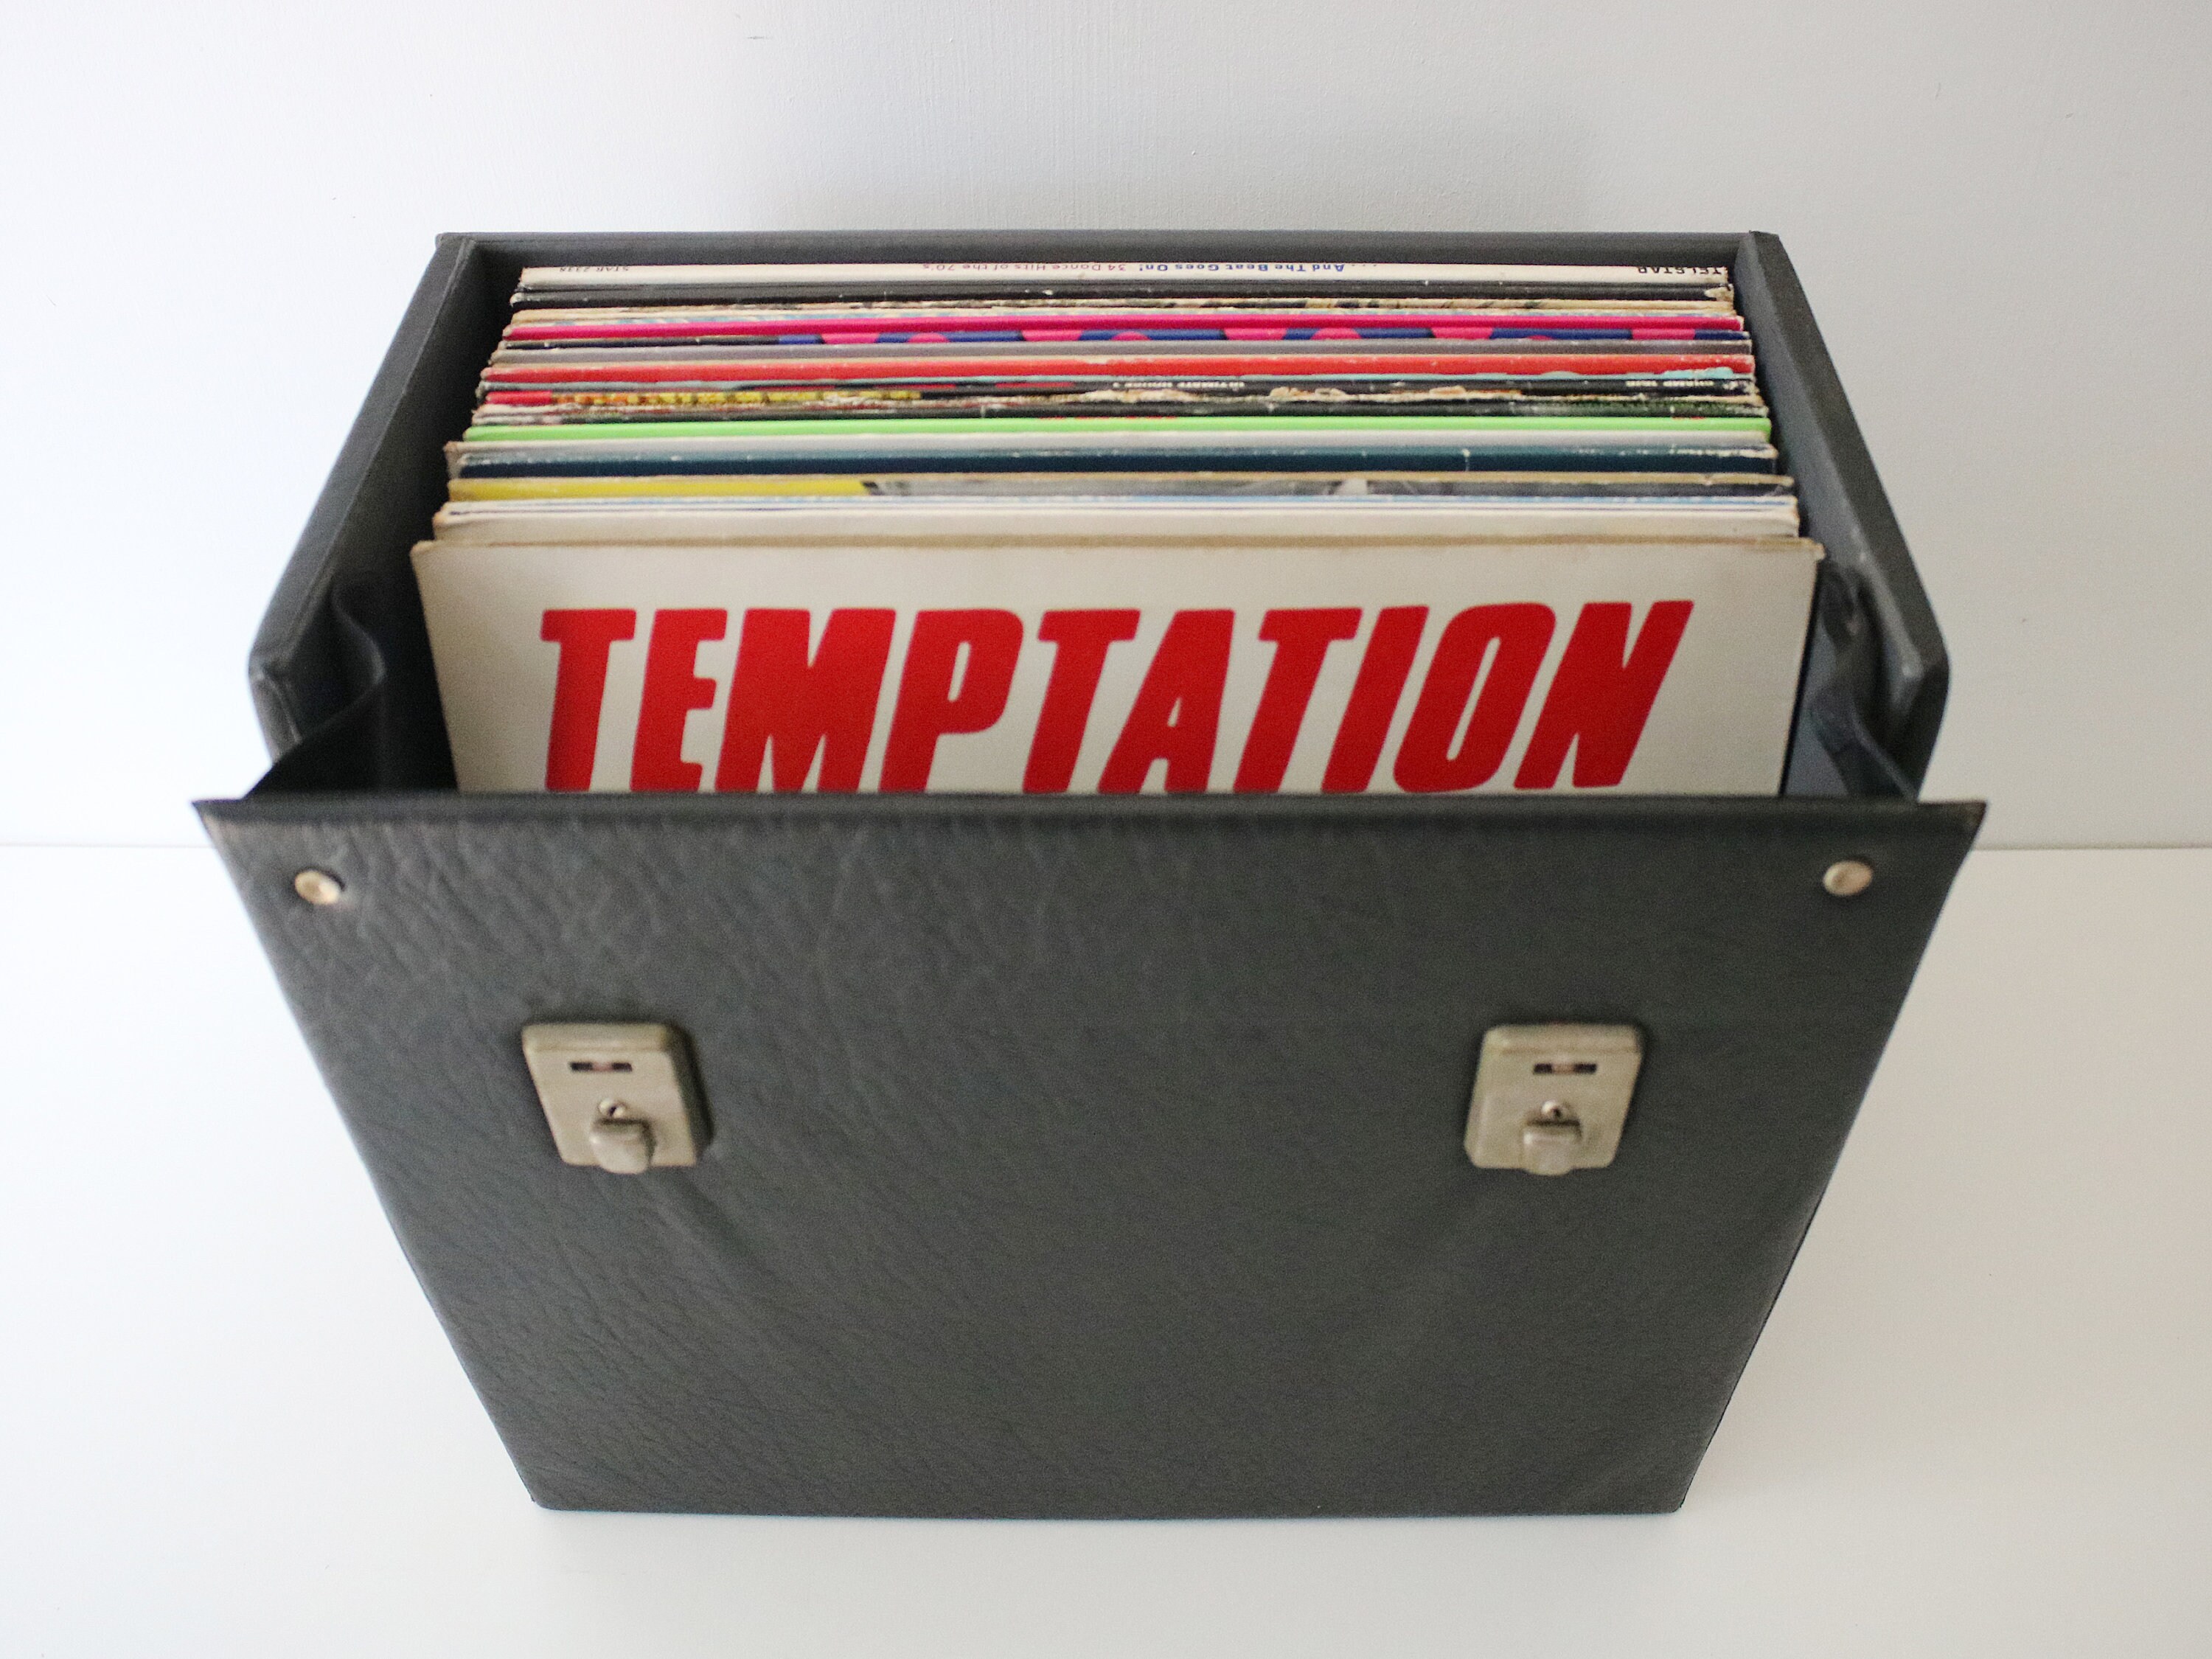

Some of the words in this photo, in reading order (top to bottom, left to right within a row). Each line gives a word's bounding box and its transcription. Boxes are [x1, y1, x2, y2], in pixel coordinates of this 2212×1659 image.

[962, 263, 989, 271] the
[993, 263, 1009, 271] of
[1015, 263, 1046, 271] Hits
[1053, 263, 1102, 271] Dance
[1107, 263, 1126, 271] 34
[1139, 263, 1169, 271] On!
[1175, 263, 1220, 271] Goes
[1225, 263, 1268, 271] Beat
[1274, 263, 1306, 271] The
[541, 601, 1694, 792] TEMPTATION
